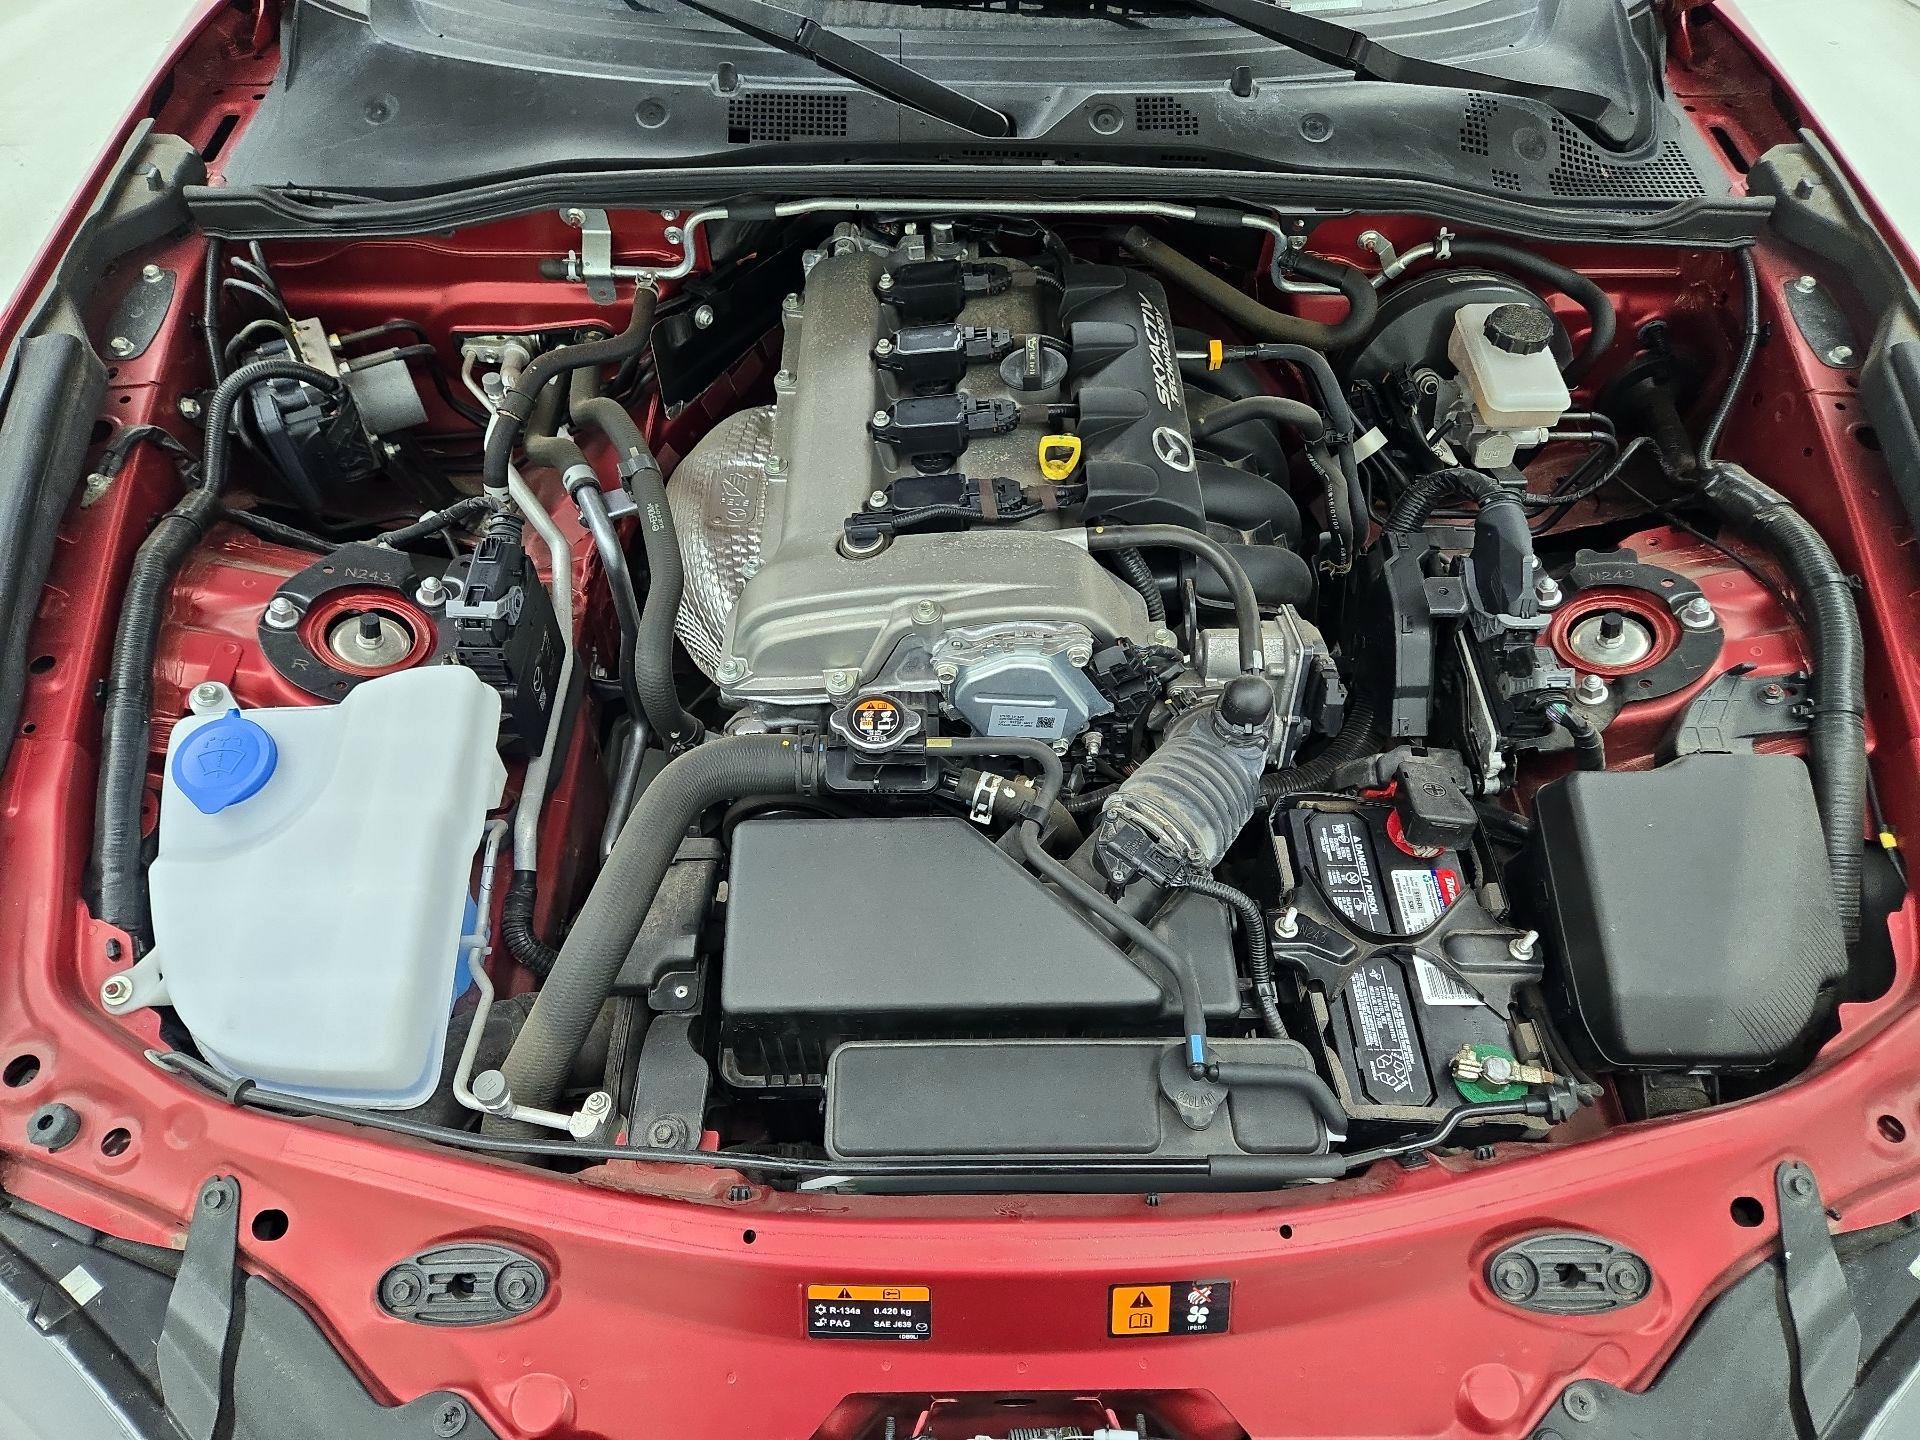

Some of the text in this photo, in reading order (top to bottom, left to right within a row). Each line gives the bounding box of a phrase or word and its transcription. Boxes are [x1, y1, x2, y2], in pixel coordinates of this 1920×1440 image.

[1137, 290, 1172, 411] SKYACTIV
[1153, 305, 1180, 406] TECHNOLOGY
[344, 567, 391, 582] N243
[291, 658, 310, 671] R
[1354, 842, 1369, 876] DANGER
[1364, 884, 1379, 915] POISON
[1444, 876, 1457, 902] Dura
[1176, 1090, 1217, 1108] COOLANT
[829, 1306, 912, 1317] R-134a 0.420 kg
[829, 1319, 851, 1328] PAG
